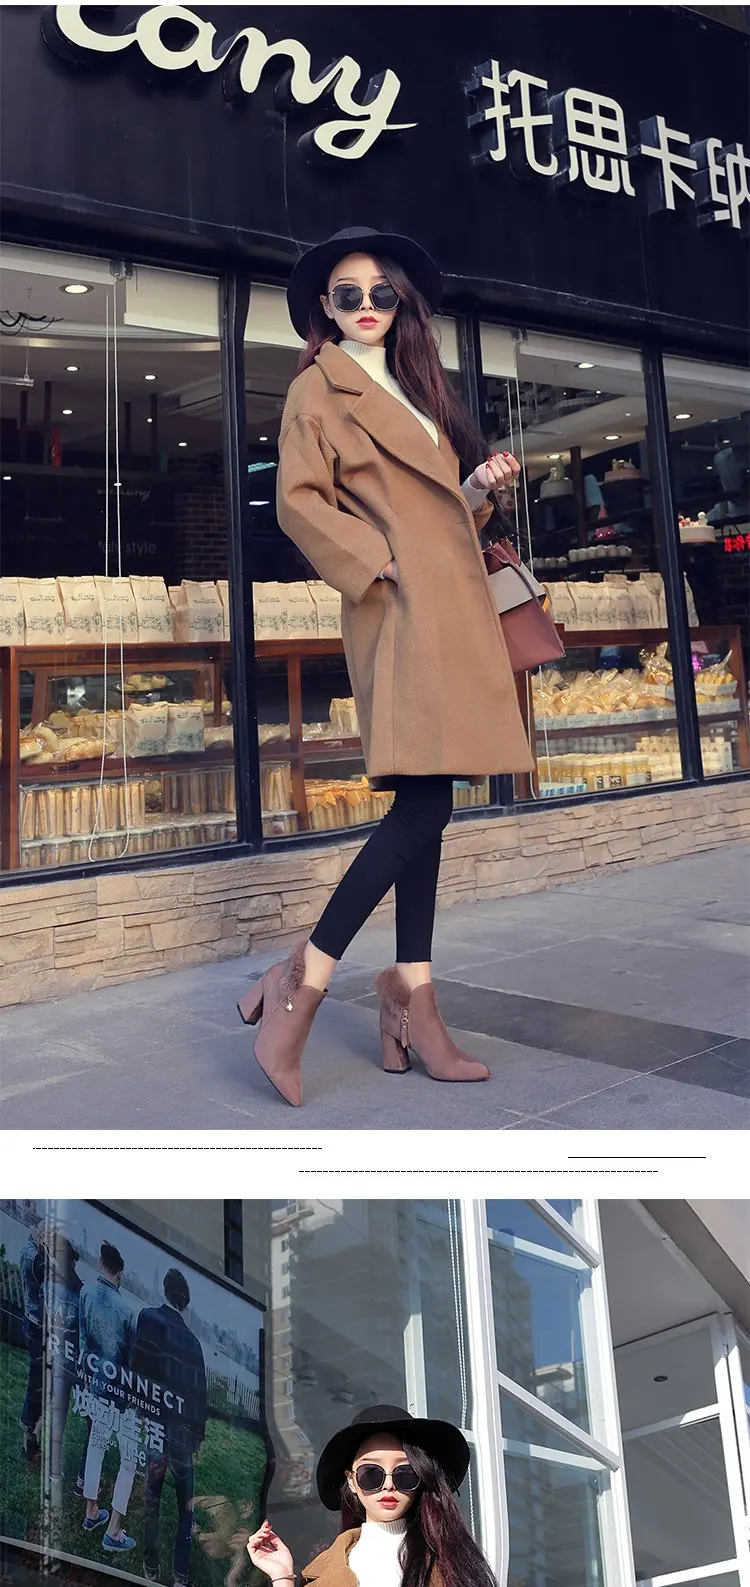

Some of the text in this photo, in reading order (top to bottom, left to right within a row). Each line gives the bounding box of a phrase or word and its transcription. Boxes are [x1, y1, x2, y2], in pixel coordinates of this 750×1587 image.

[481, 59, 750, 229] 托思卡纳
[49, 1332, 185, 1414] RE/CONNECT
[76, 1369, 161, 1416] WITH YOUR FRIENDS
